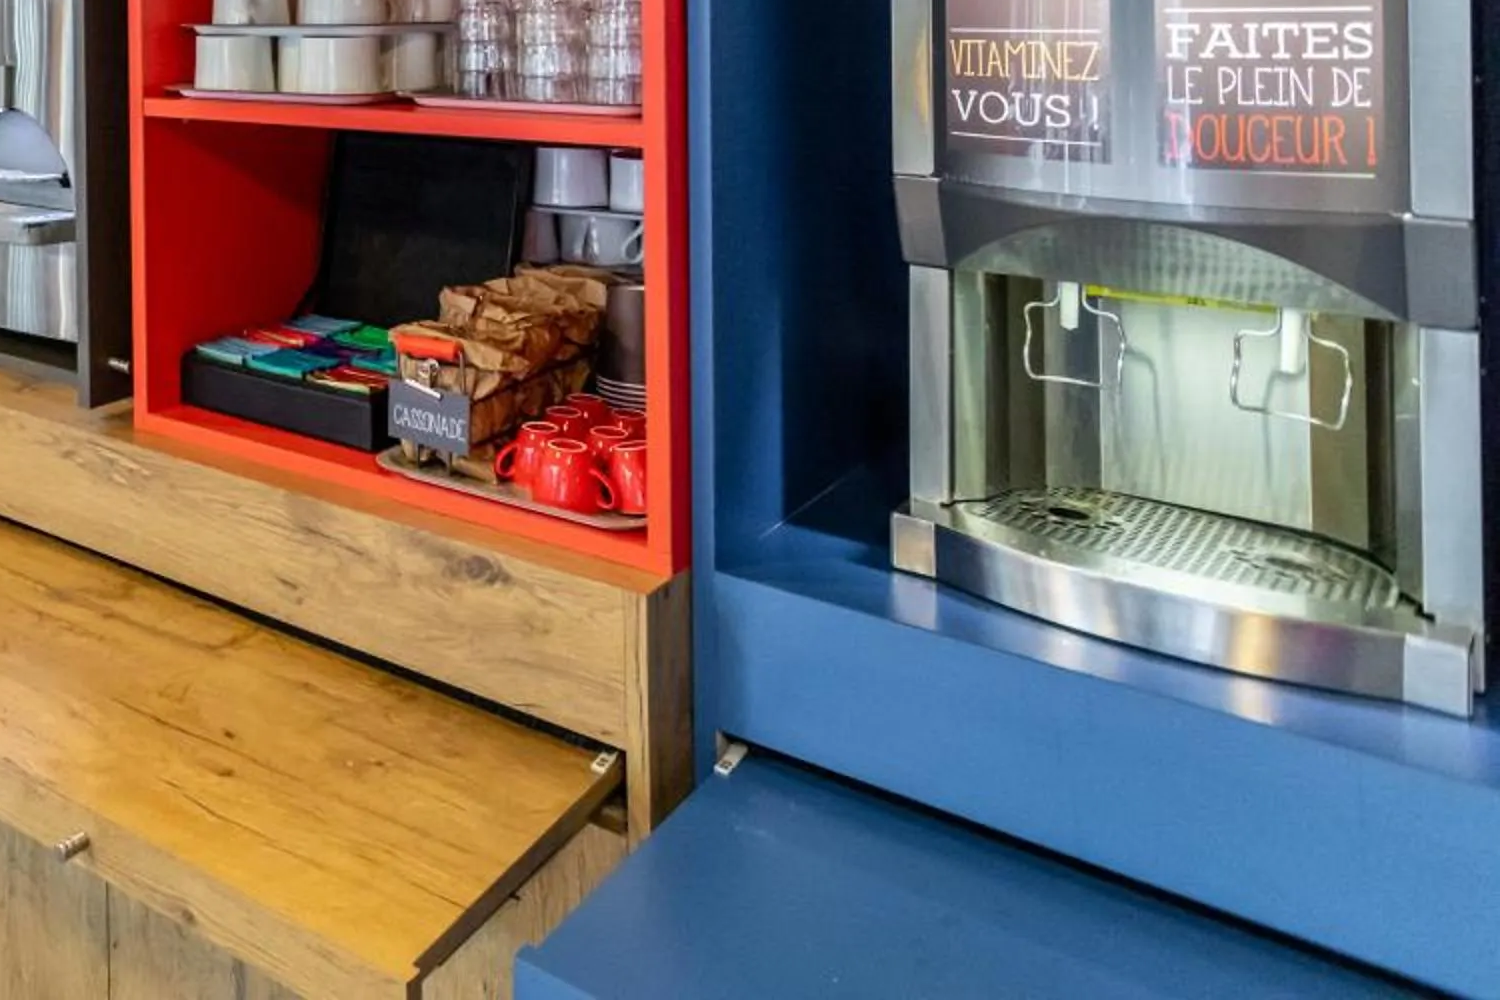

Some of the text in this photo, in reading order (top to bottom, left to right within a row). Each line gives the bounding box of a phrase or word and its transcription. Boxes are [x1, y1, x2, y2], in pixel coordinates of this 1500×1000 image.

[949, 38, 1100, 81] VITAMINEZ
[1164, 21, 1374, 61] FAITES
[1166, 66, 1372, 107] LE PLEIN DE
[951, 88, 1072, 129] VOUS
[1164, 108, 1348, 166] DOUCEUR
[393, 403, 466, 441] CASSONADE
